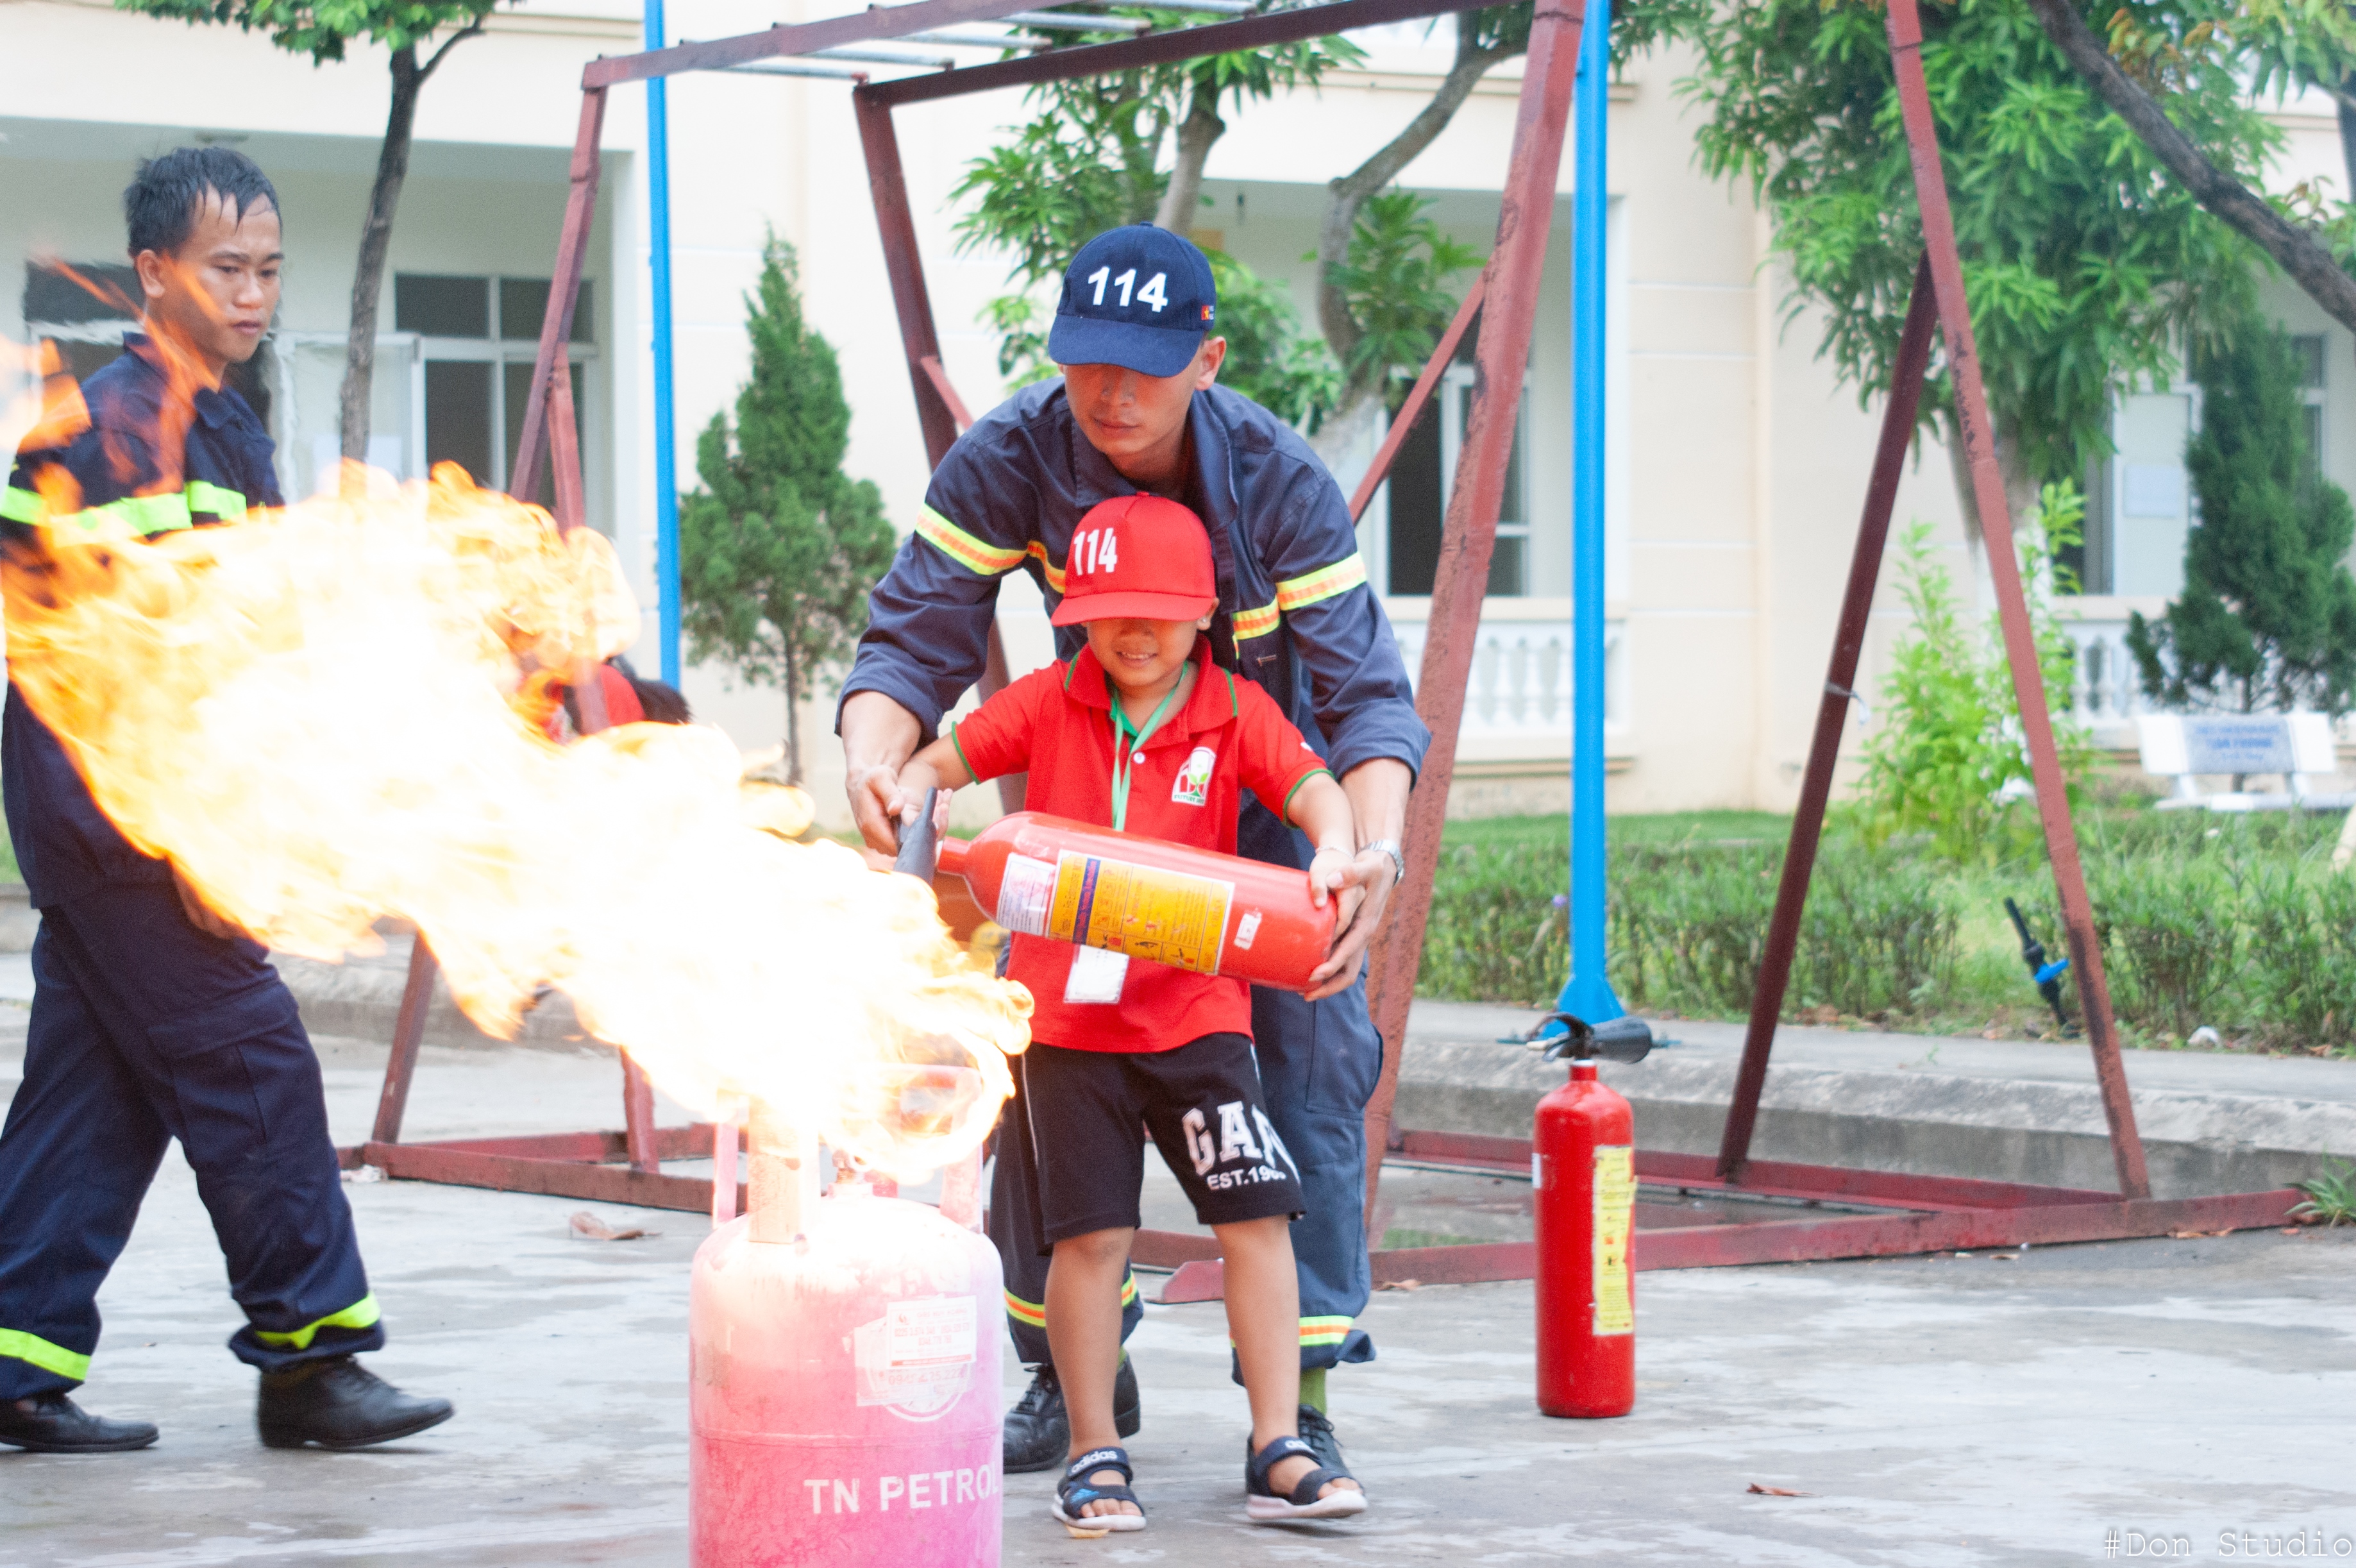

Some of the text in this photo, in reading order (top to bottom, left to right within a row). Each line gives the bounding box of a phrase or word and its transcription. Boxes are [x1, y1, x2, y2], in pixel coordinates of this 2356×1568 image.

[1088, 266, 1168, 312] 114
[1073, 527, 1118, 575] 114
[1071, 1451, 1118, 1473] adidas
[804, 1460, 998, 1514] TN PETROL
